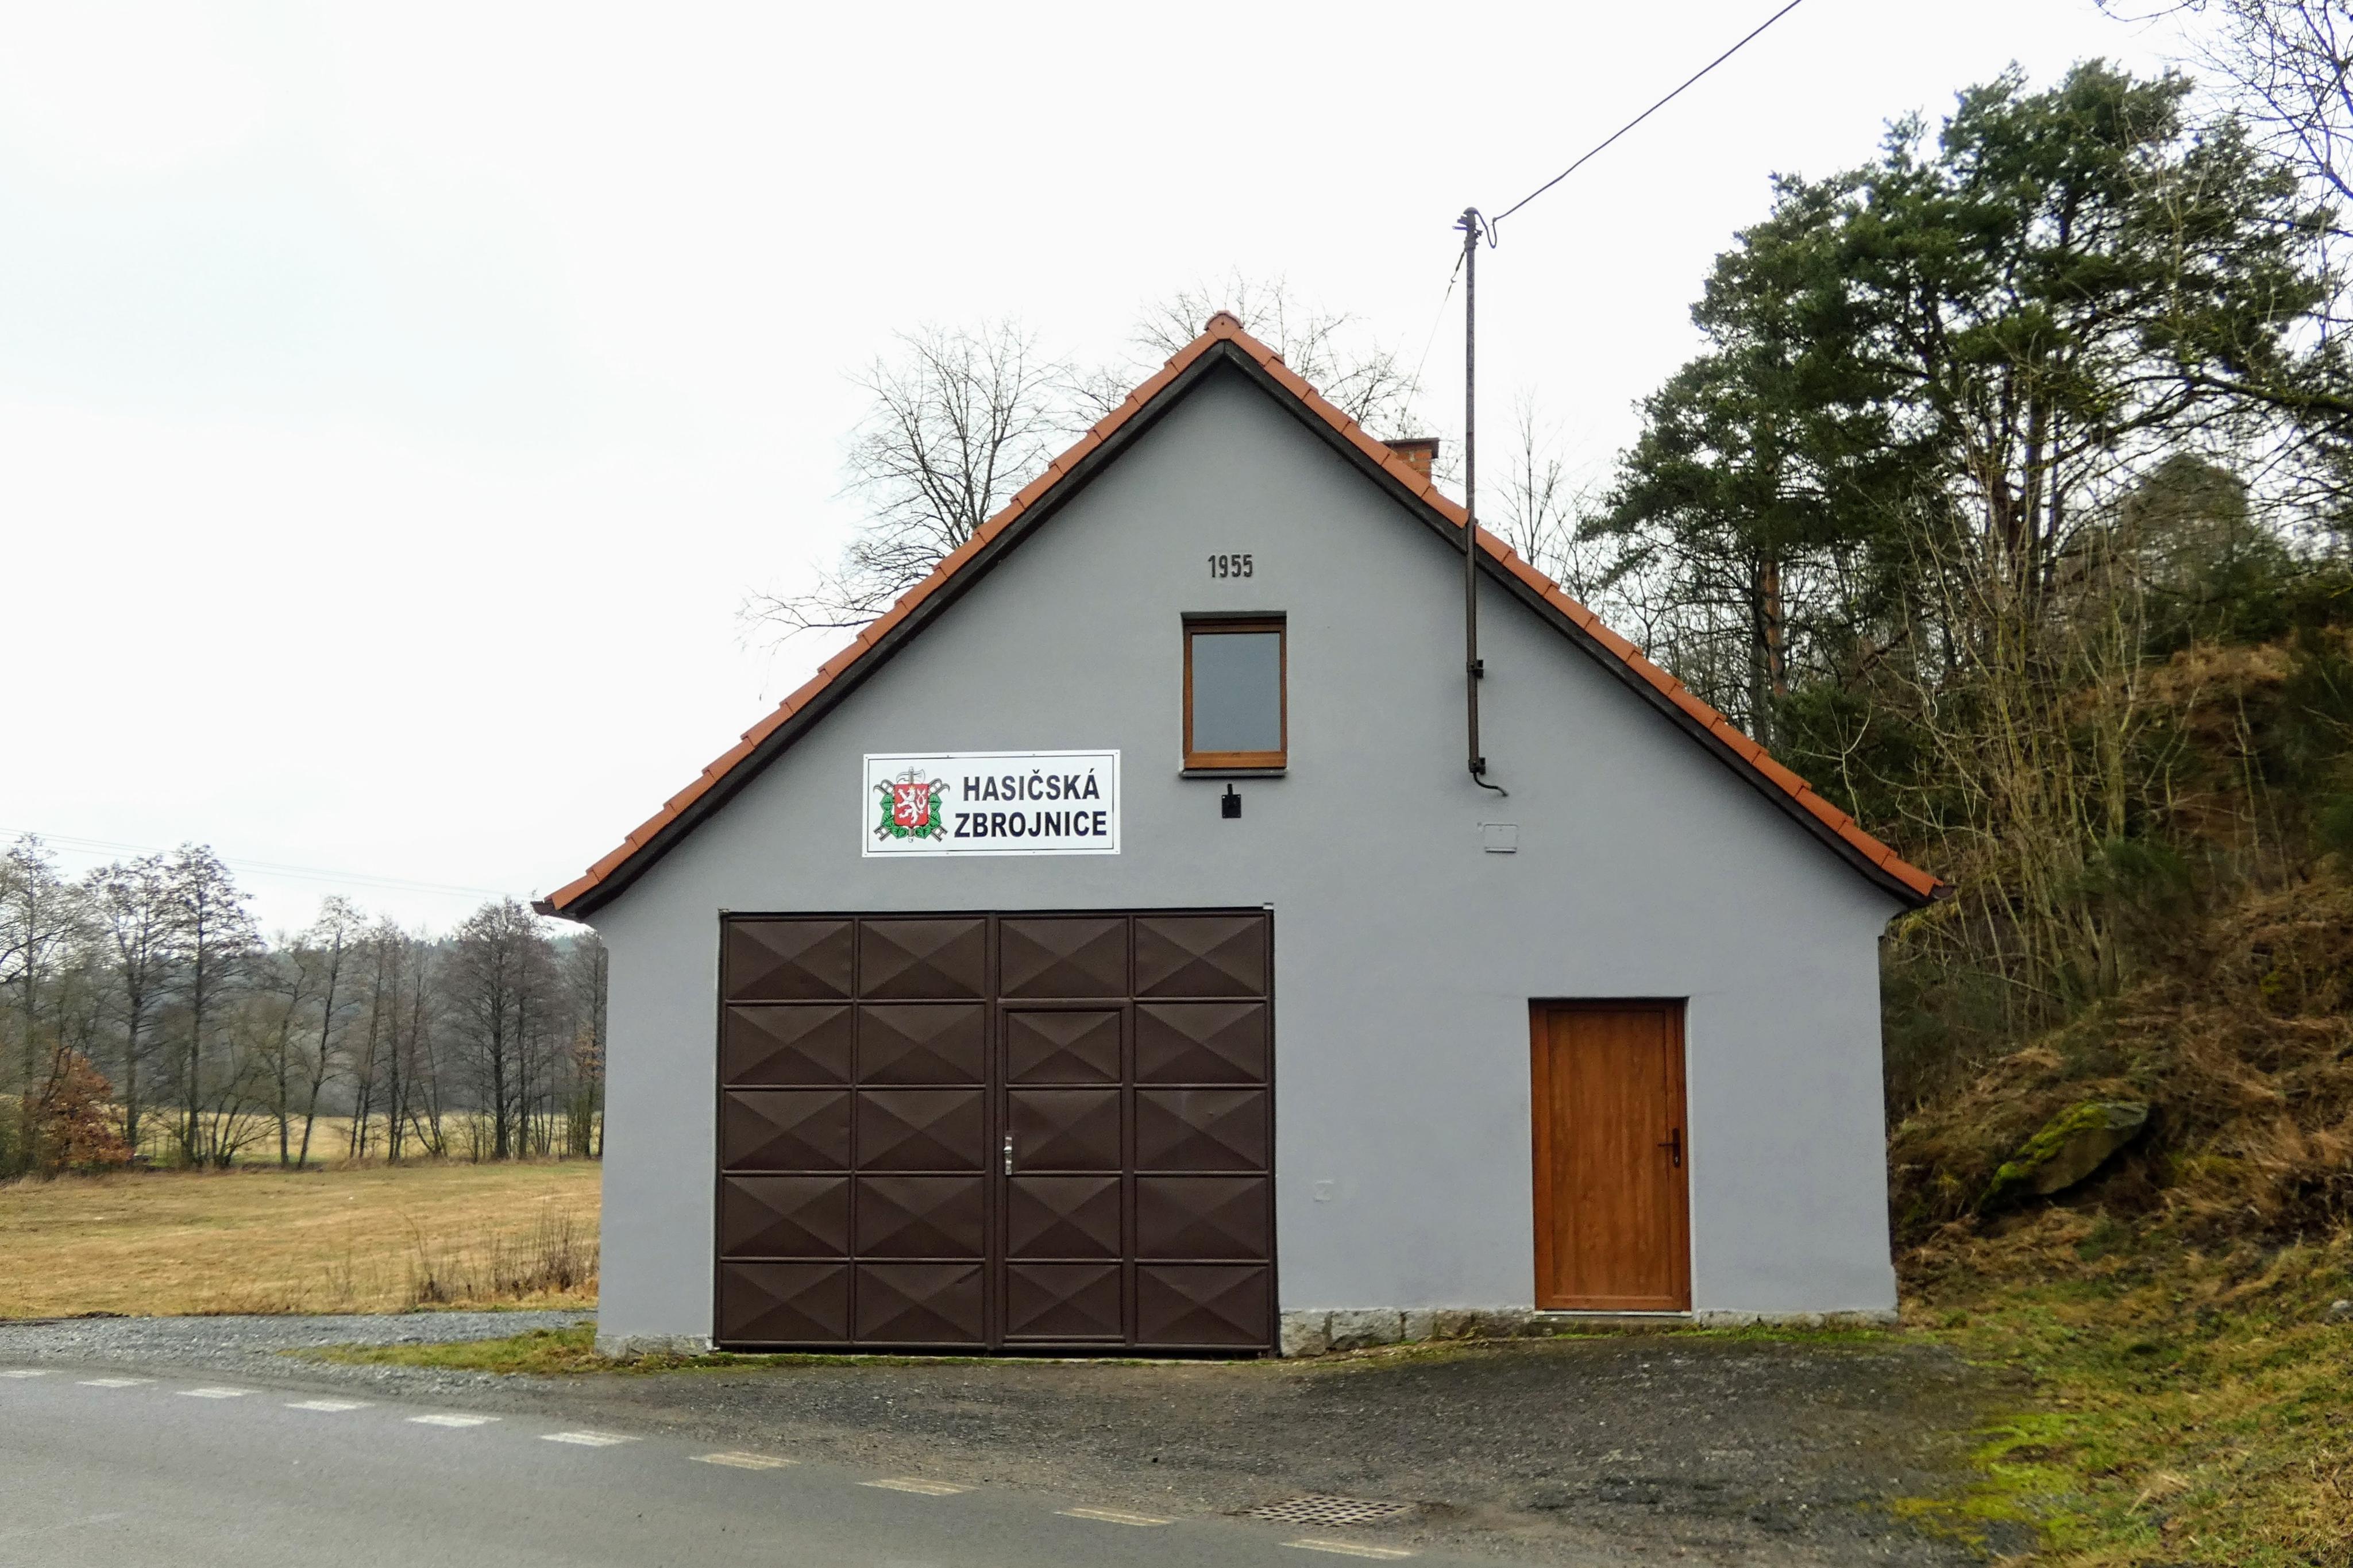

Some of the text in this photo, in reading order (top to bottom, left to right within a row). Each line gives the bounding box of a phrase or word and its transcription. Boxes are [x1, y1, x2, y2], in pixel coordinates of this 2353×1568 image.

[1208, 554, 1253, 578] 1955
[963, 768, 1100, 801] HASIČSKÁ
[954, 810, 1108, 838] ZBROJNICE
